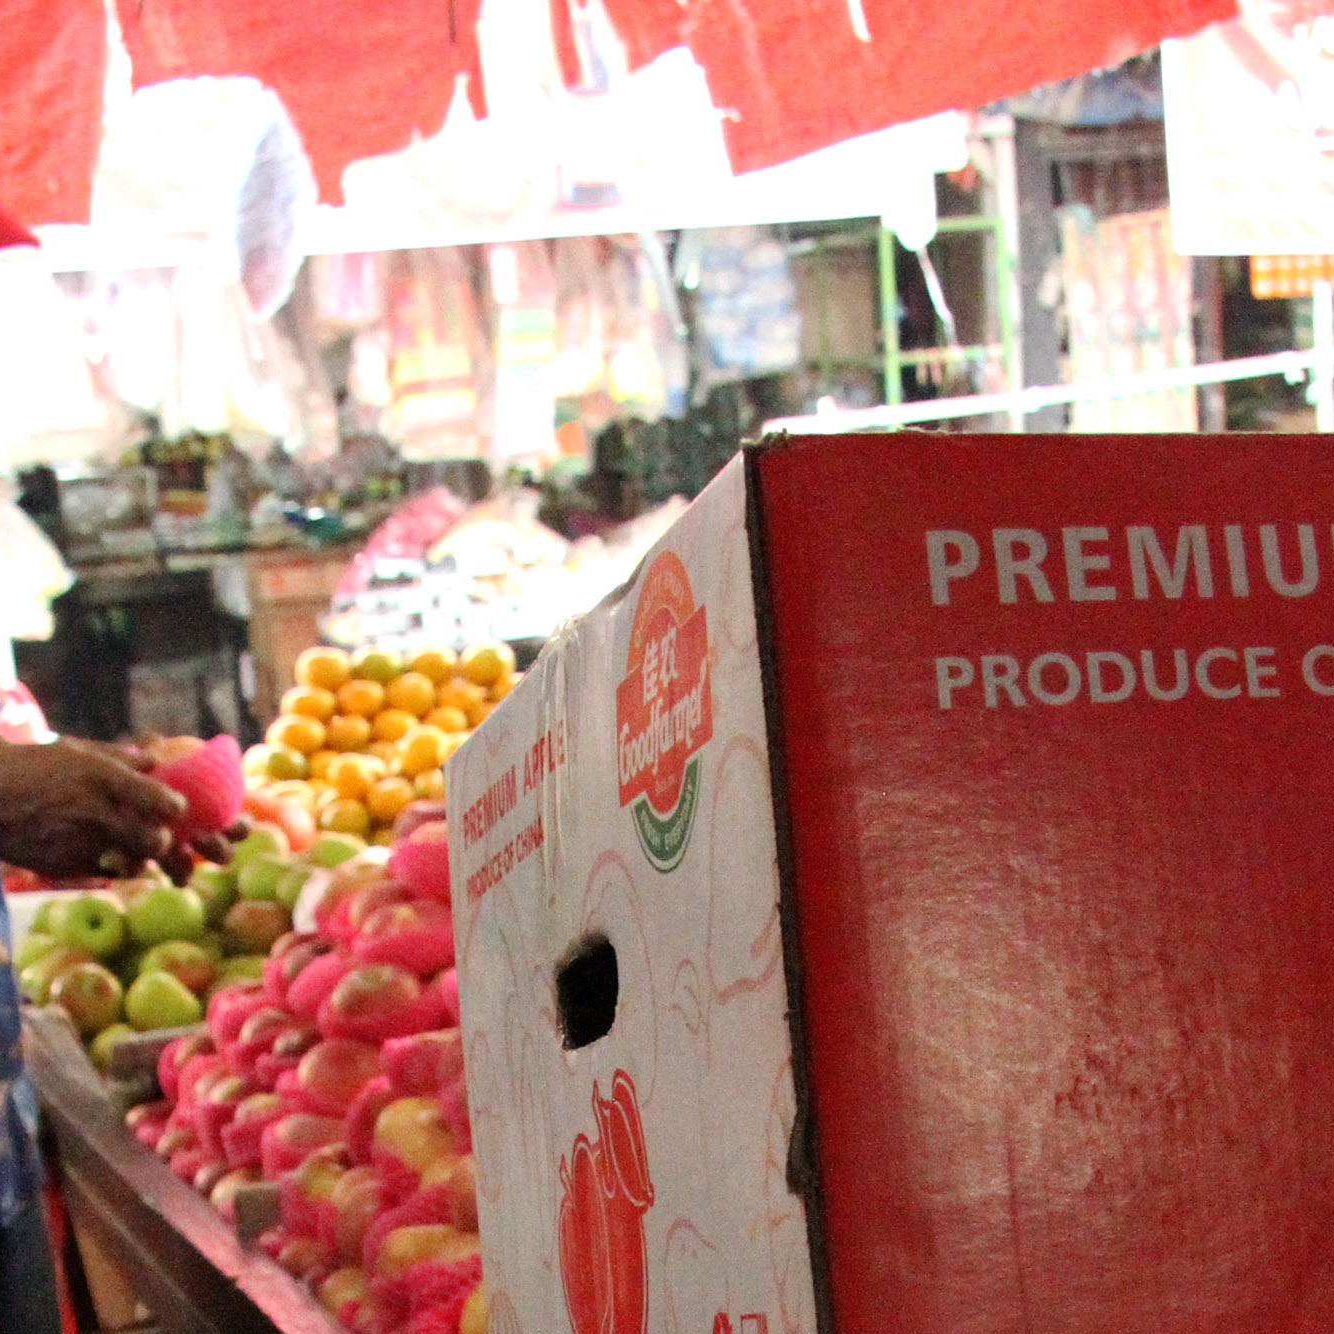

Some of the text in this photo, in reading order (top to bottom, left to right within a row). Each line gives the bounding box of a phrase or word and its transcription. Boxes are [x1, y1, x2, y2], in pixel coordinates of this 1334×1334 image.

[619, 656, 708, 786] Goodfarmer
[934, 645, 1281, 710] PRODUCE
[463, 719, 565, 851] PREMIUM APPLE
[467, 814, 545, 906] PRODUCE OF CHINA
